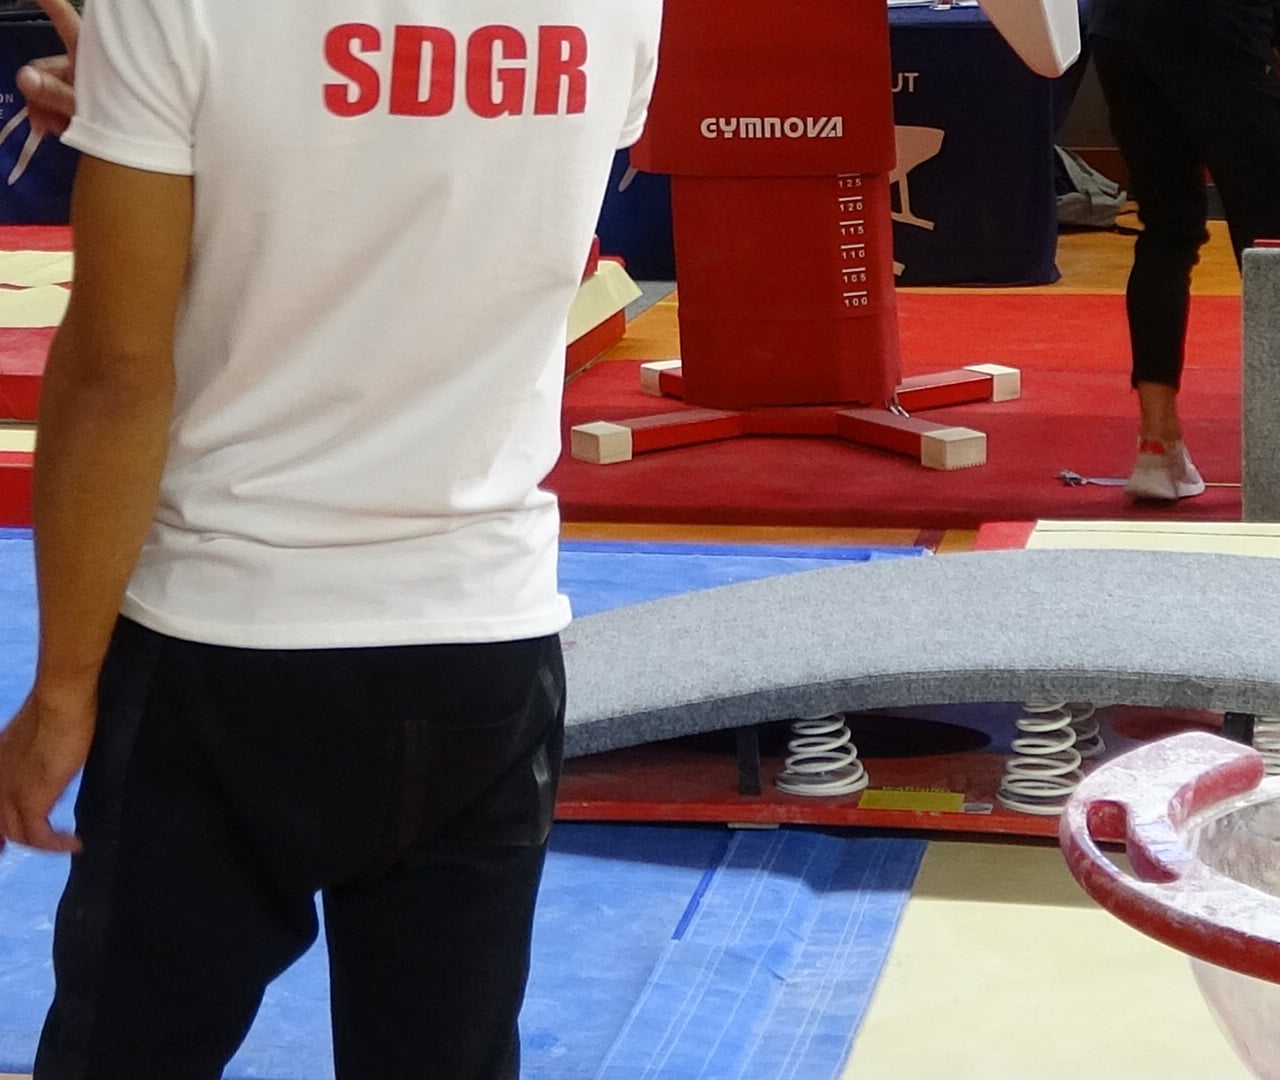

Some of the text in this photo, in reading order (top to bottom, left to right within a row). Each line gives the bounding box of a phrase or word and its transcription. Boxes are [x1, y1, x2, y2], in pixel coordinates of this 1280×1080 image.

[323, 22, 589, 118] SDGR
[700, 116, 843, 139] GYMNOVA
[838, 176, 861, 187] 125
[840, 200, 863, 211] 120
[841, 224, 864, 235] 115
[842, 248, 865, 259] 110
[843, 272, 866, 283] 105
[844, 296, 868, 307] 100
